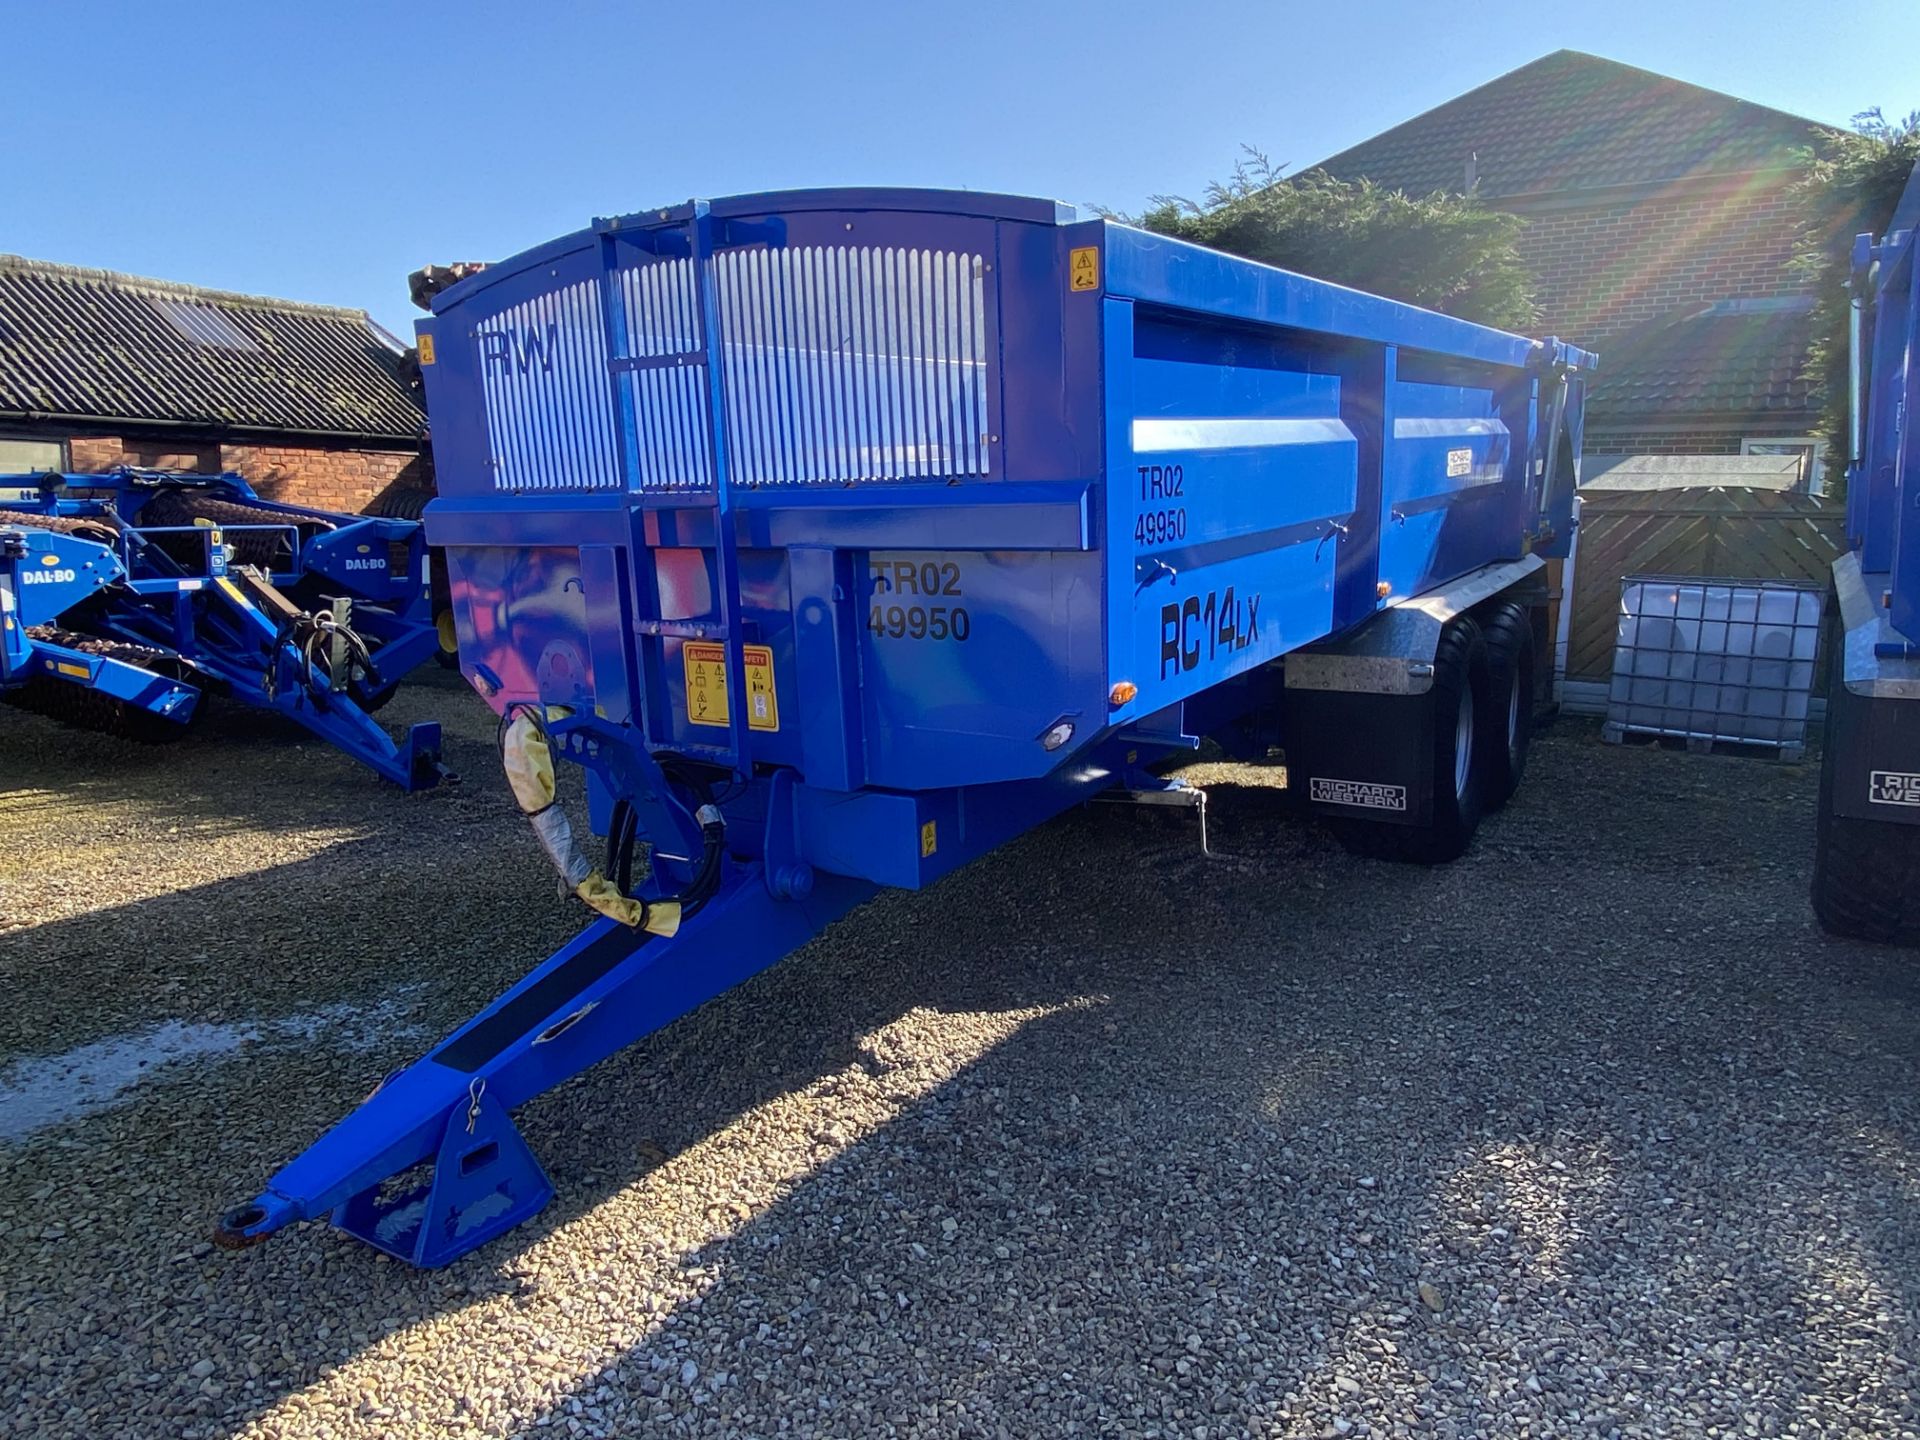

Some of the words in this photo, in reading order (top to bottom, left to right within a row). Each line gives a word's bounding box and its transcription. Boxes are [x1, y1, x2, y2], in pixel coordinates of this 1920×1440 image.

[482, 323, 557, 379] RW
[1137, 464, 1185, 501] TR02
[1134, 507, 1187, 546] 49950
[869, 561, 962, 596] TR02
[866, 604, 970, 642] 49950
[1317, 789, 1400, 808] WESTERN
[1319, 781, 1396, 798] RICHARD
